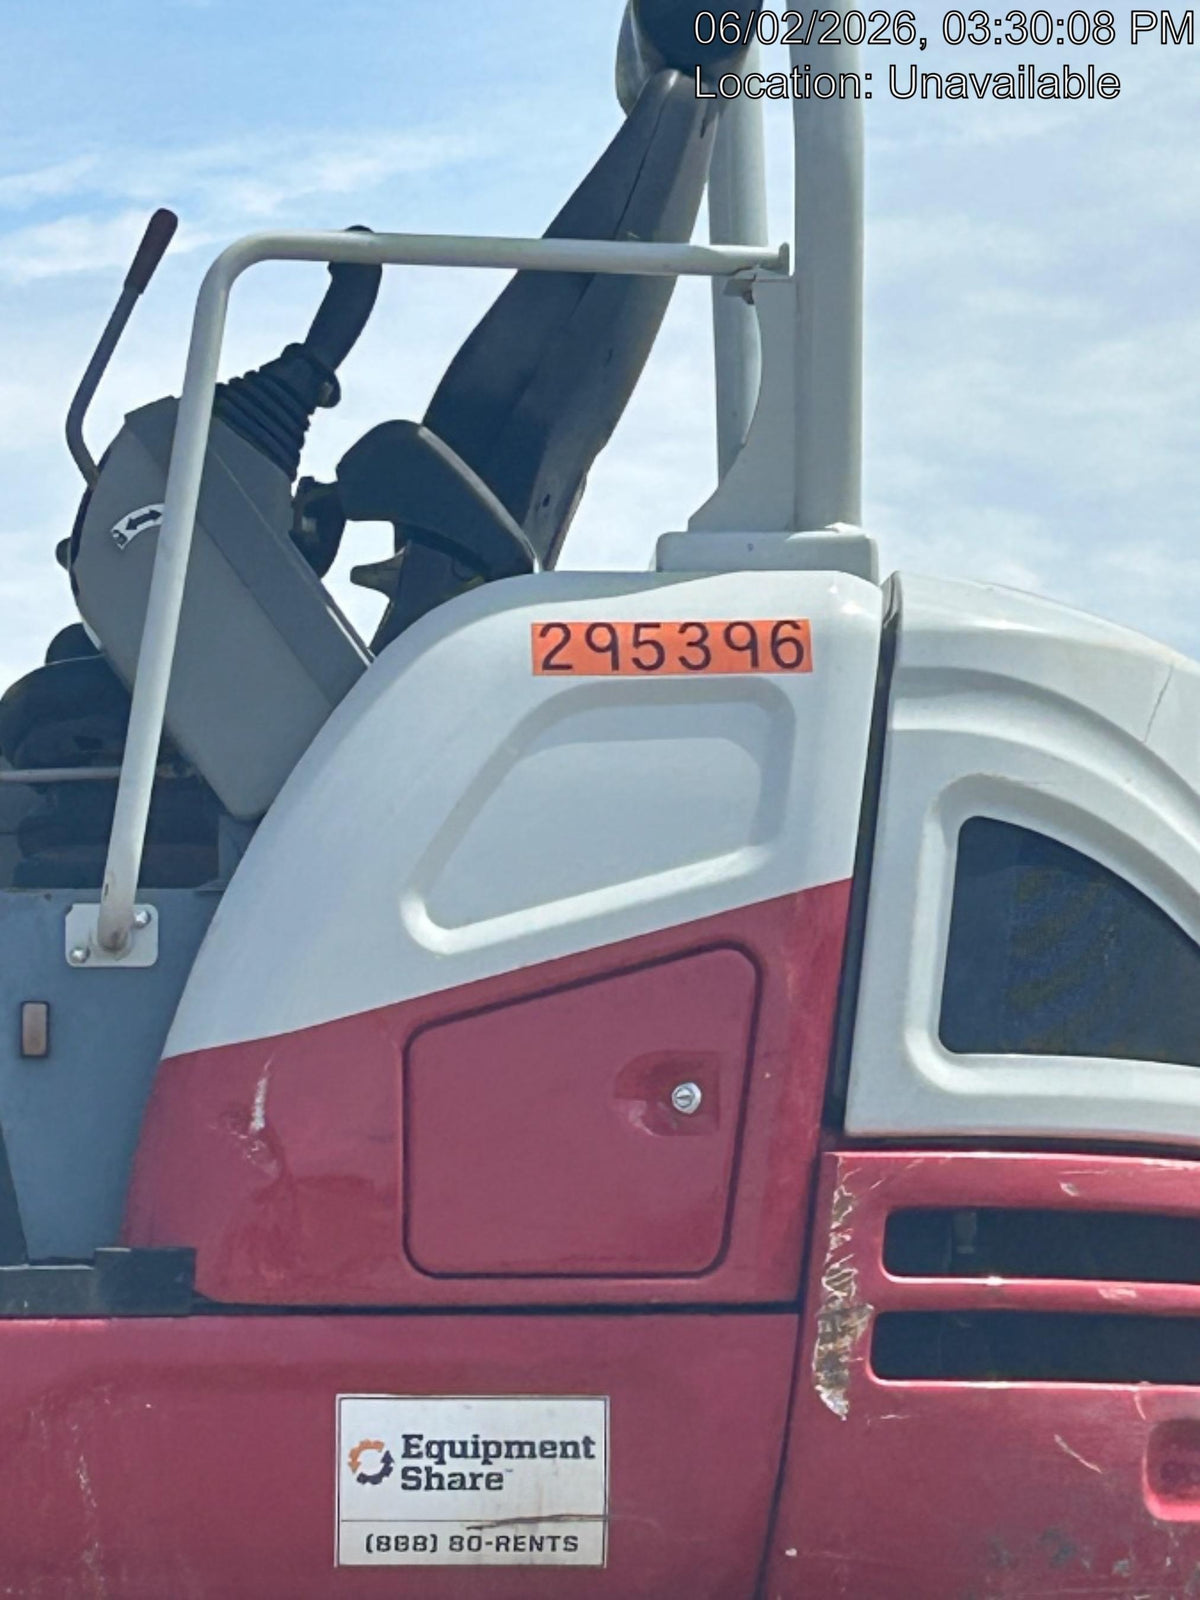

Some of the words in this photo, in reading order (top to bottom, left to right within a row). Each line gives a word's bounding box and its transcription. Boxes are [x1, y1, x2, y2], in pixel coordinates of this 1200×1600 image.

[538, 620, 804, 671] 295396
[401, 1434, 596, 1465] Equipment
[400, 1466, 504, 1491] Share
[365, 1533, 438, 1553] (888)
[448, 1534, 579, 1553] 80-RENTS
